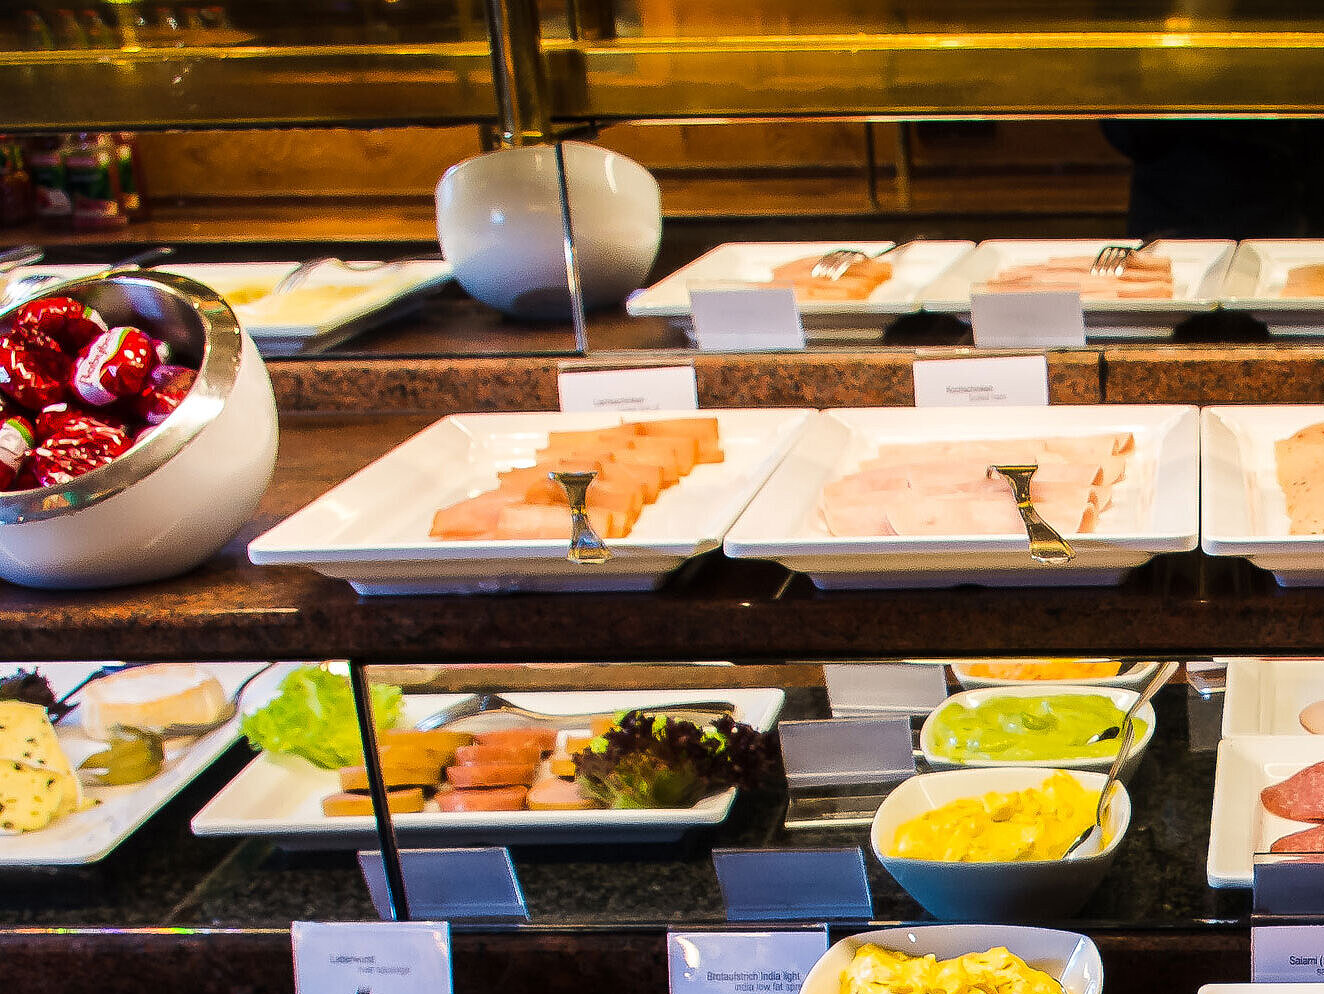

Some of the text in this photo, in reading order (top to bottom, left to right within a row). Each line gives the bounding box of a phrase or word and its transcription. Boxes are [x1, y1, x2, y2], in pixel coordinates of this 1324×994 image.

[1289, 955, 1318, 966] Salami
[706, 970, 800, 983] Brotaufstrich India light
